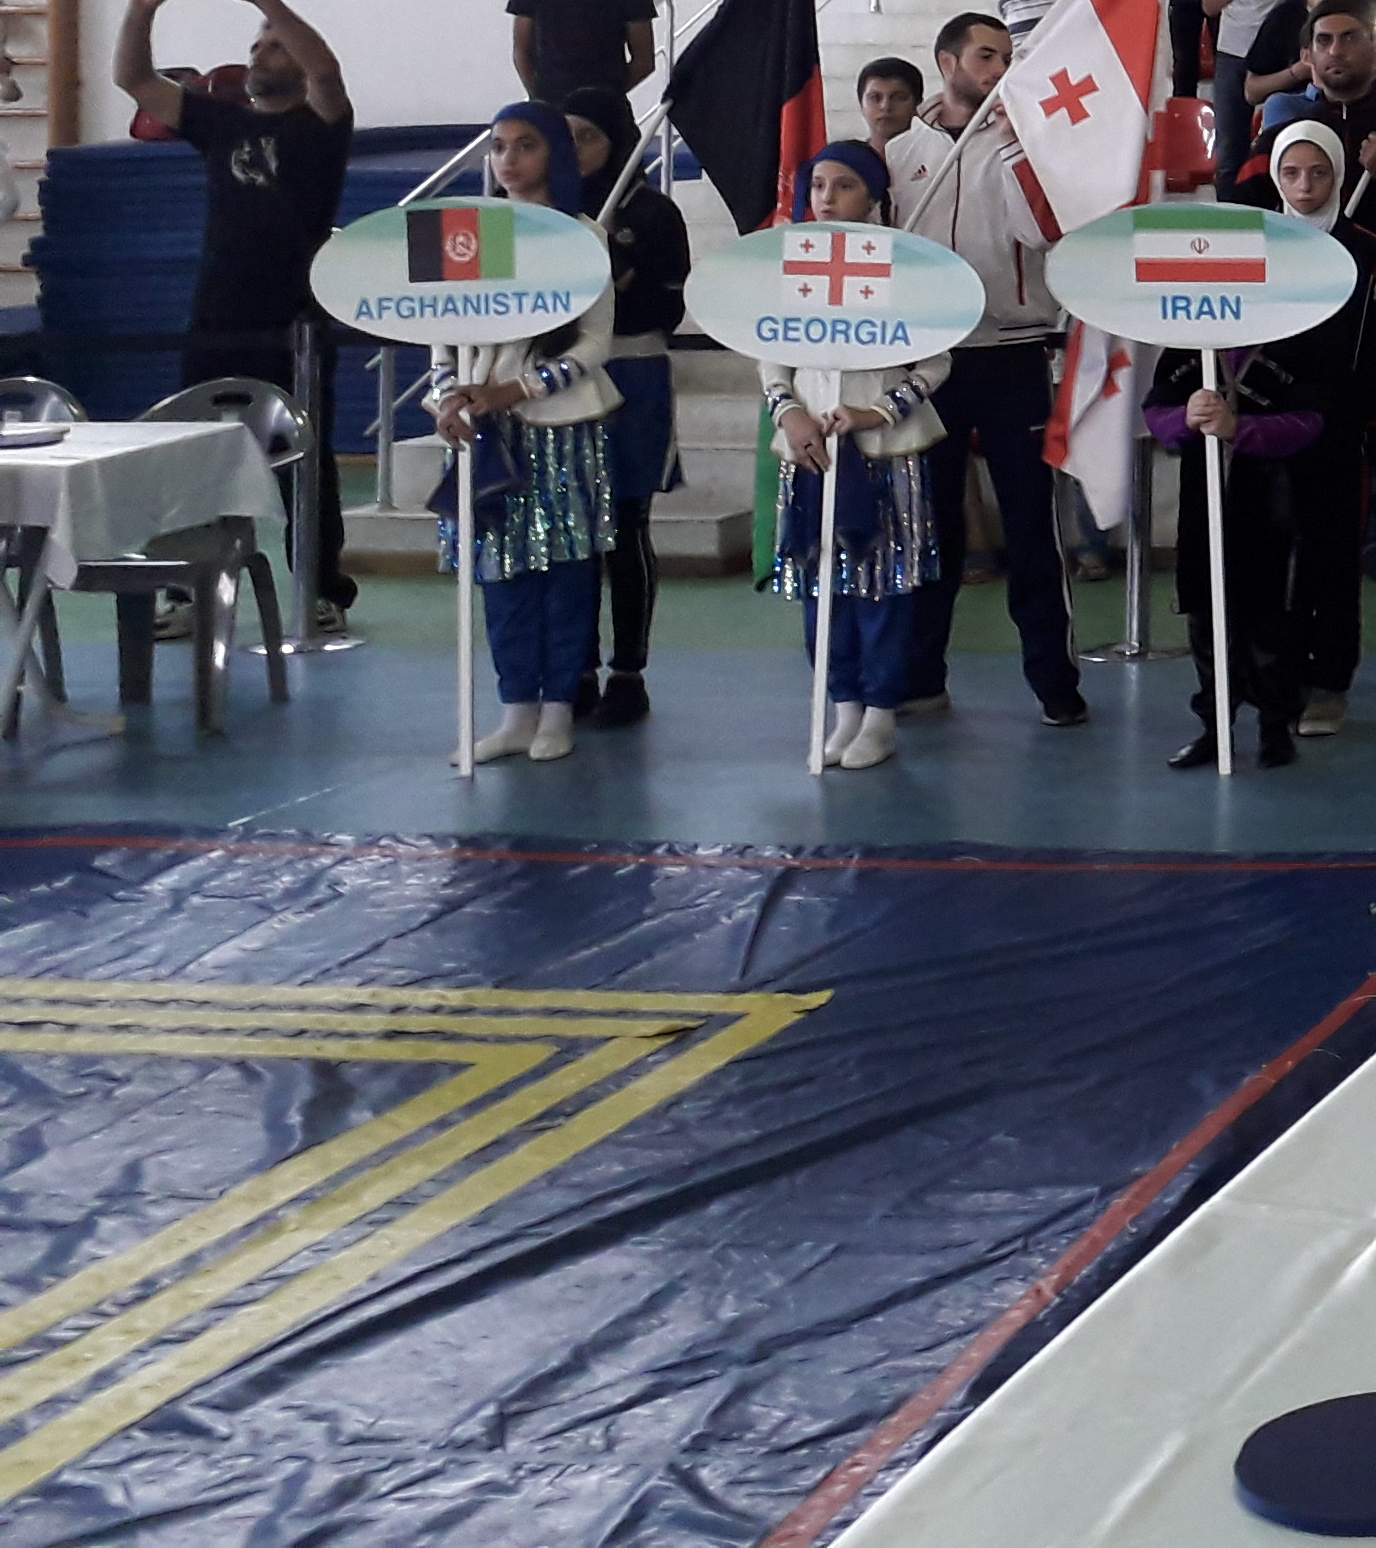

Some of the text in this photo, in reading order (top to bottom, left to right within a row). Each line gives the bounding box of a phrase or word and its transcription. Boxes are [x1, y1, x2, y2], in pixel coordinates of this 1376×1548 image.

[355, 290, 572, 322] AFGHANISTAN
[1160, 294, 1242, 321] IRAN
[756, 315, 912, 346] GEORGIA
